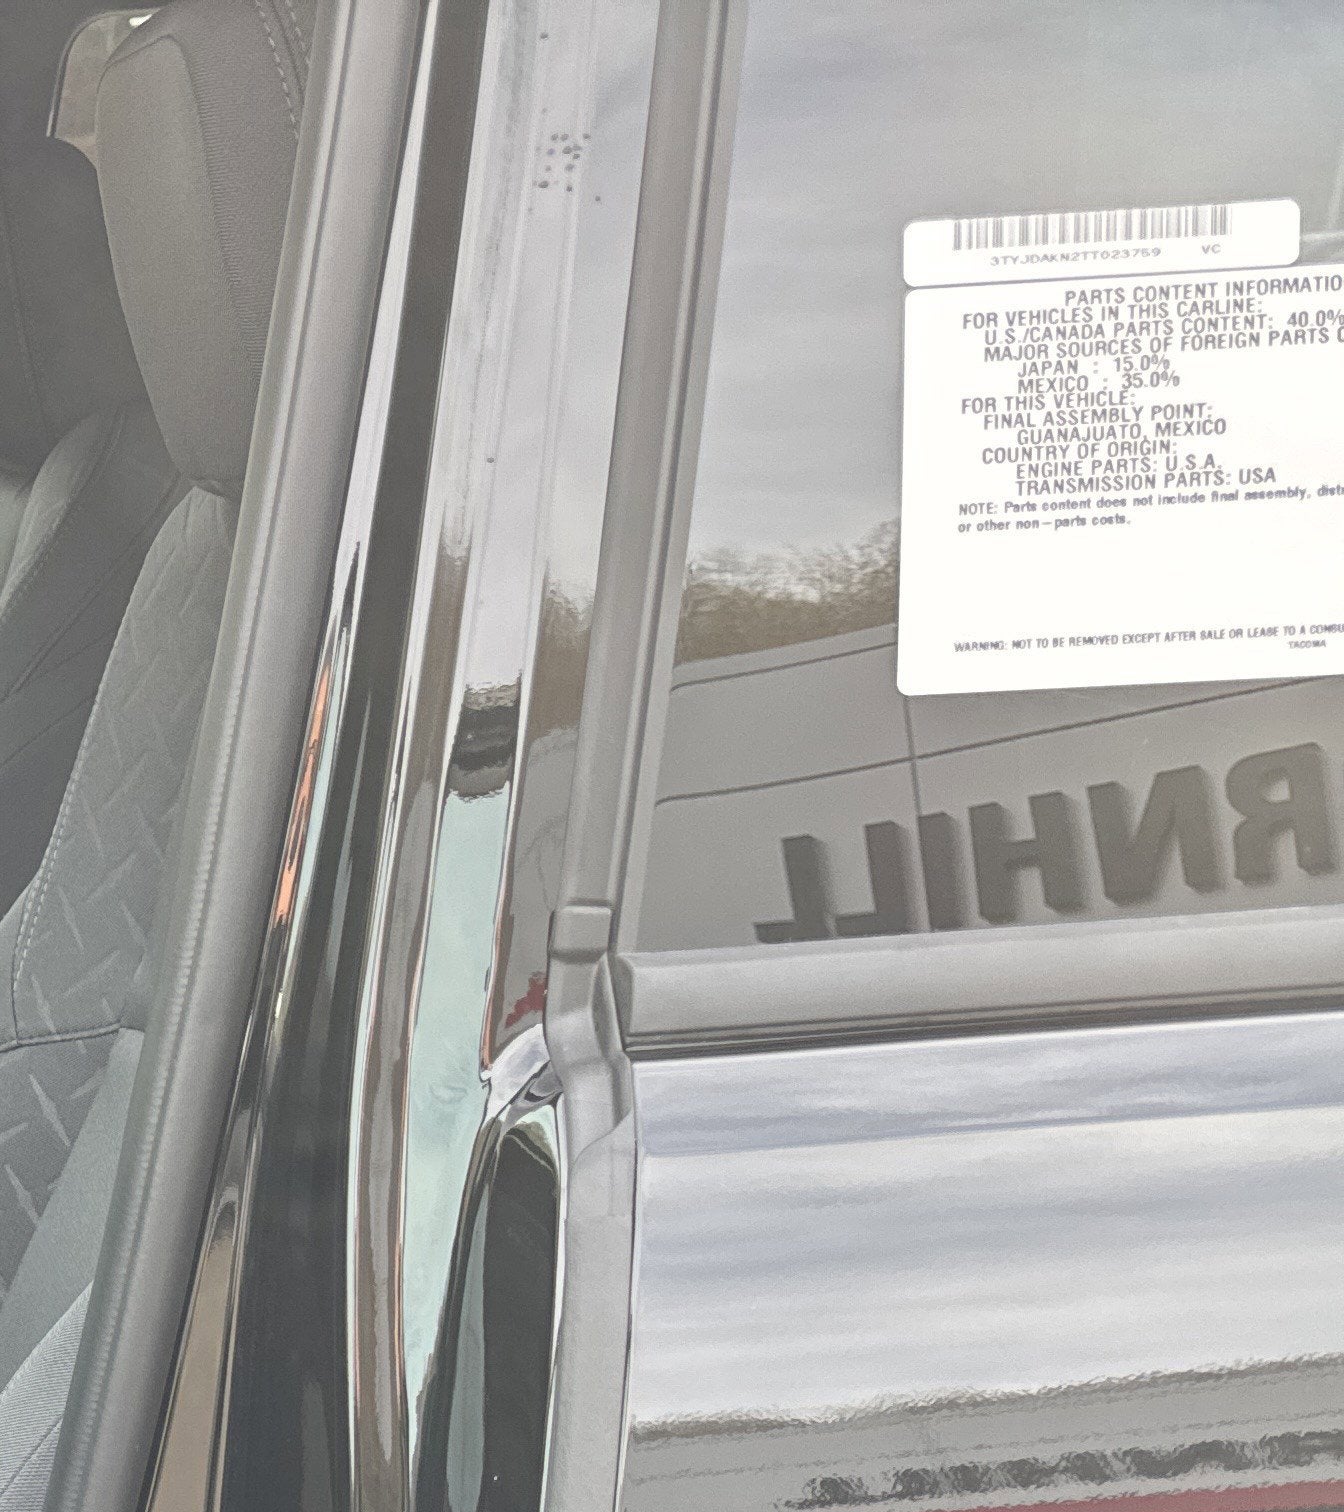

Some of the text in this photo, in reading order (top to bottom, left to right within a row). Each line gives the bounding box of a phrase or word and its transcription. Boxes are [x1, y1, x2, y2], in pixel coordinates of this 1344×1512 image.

[1064, 275, 1343, 305] PARTS CONTENT INFORMATIO
[962, 298, 1263, 329] FOR VEHICLES IN THIS CARLINE:
[984, 309, 1344, 348] U.S./CANADA PARTS CONTENT: 40.0%
[983, 344, 1049, 363] MAJOR
[1056, 338, 1143, 358] SOURCES
[1149, 336, 1173, 355] OF
[1180, 332, 1261, 351] FOREIGN
[1268, 327, 1330, 346] PARTS
[1017, 359, 1079, 378] JAPAN
[1114, 354, 1171, 374] 15.0%
[1017, 376, 1089, 394] MEXICO
[1121, 370, 1181, 391] 35.0%
[961, 391, 1136, 414] FOR THIS VEHICLE:
[983, 403, 1213, 430] FINAL ASSEMBLY POINT:
[1015, 418, 1227, 446] GUANAJUATO, MEXICO
[981, 439, 1177, 463] COUNTRY OF ORIGIN:
[1015, 454, 1222, 480] ENGINE PARTS: U.S.A.
[1015, 467, 1277, 496] TRANSMISSION PARTS: USA
[959, 502, 997, 515] NOTE:
[1005, 501, 1037, 513] Parts
[1042, 498, 1091, 511] content
[1096, 497, 1127, 508] does
[1133, 495, 1153, 506] not
[1158, 493, 1205, 505] include
[1211, 489, 1239, 502] final
[1244, 486, 1310, 500] assembly,
[958, 523, 971, 533] or
[977, 519, 1010, 531] other
[1092, 513, 1130, 526] costs.
